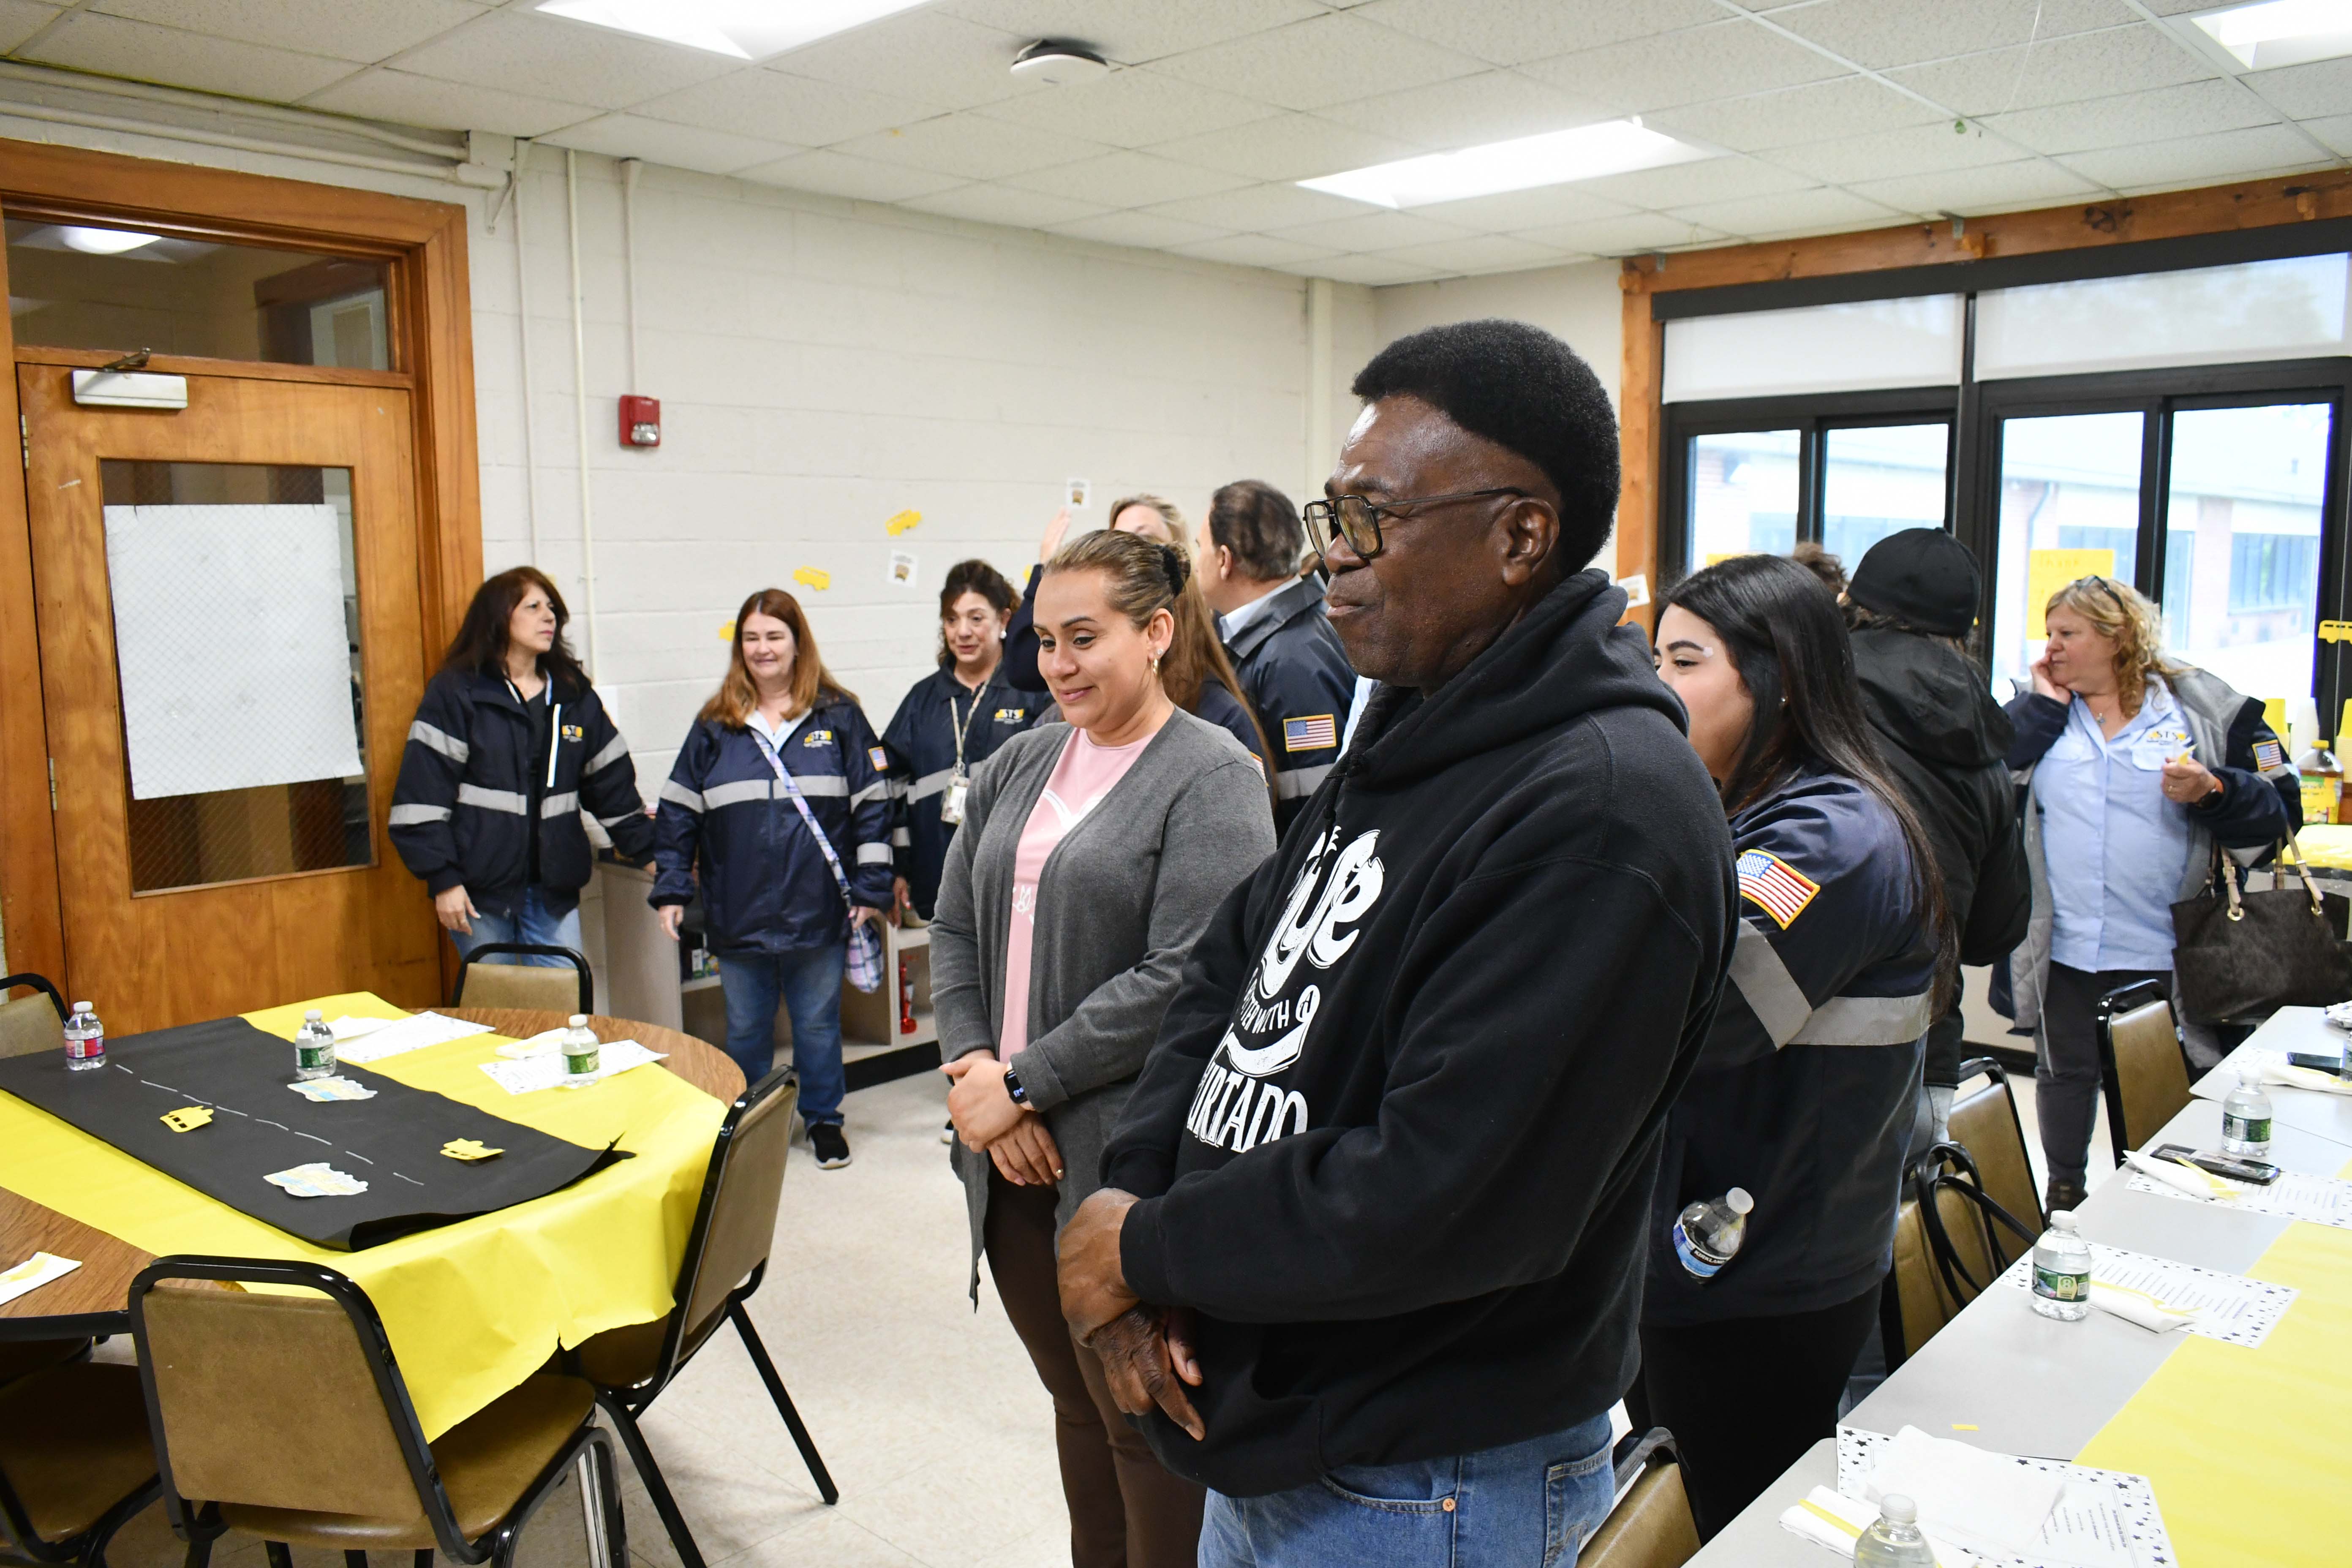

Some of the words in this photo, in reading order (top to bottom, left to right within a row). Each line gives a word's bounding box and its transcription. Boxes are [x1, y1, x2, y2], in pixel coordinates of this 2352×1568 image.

[1003, 708, 1020, 720] STS
[2156, 730, 2179, 740] STS
[1252, 999, 1290, 1034] WITH
